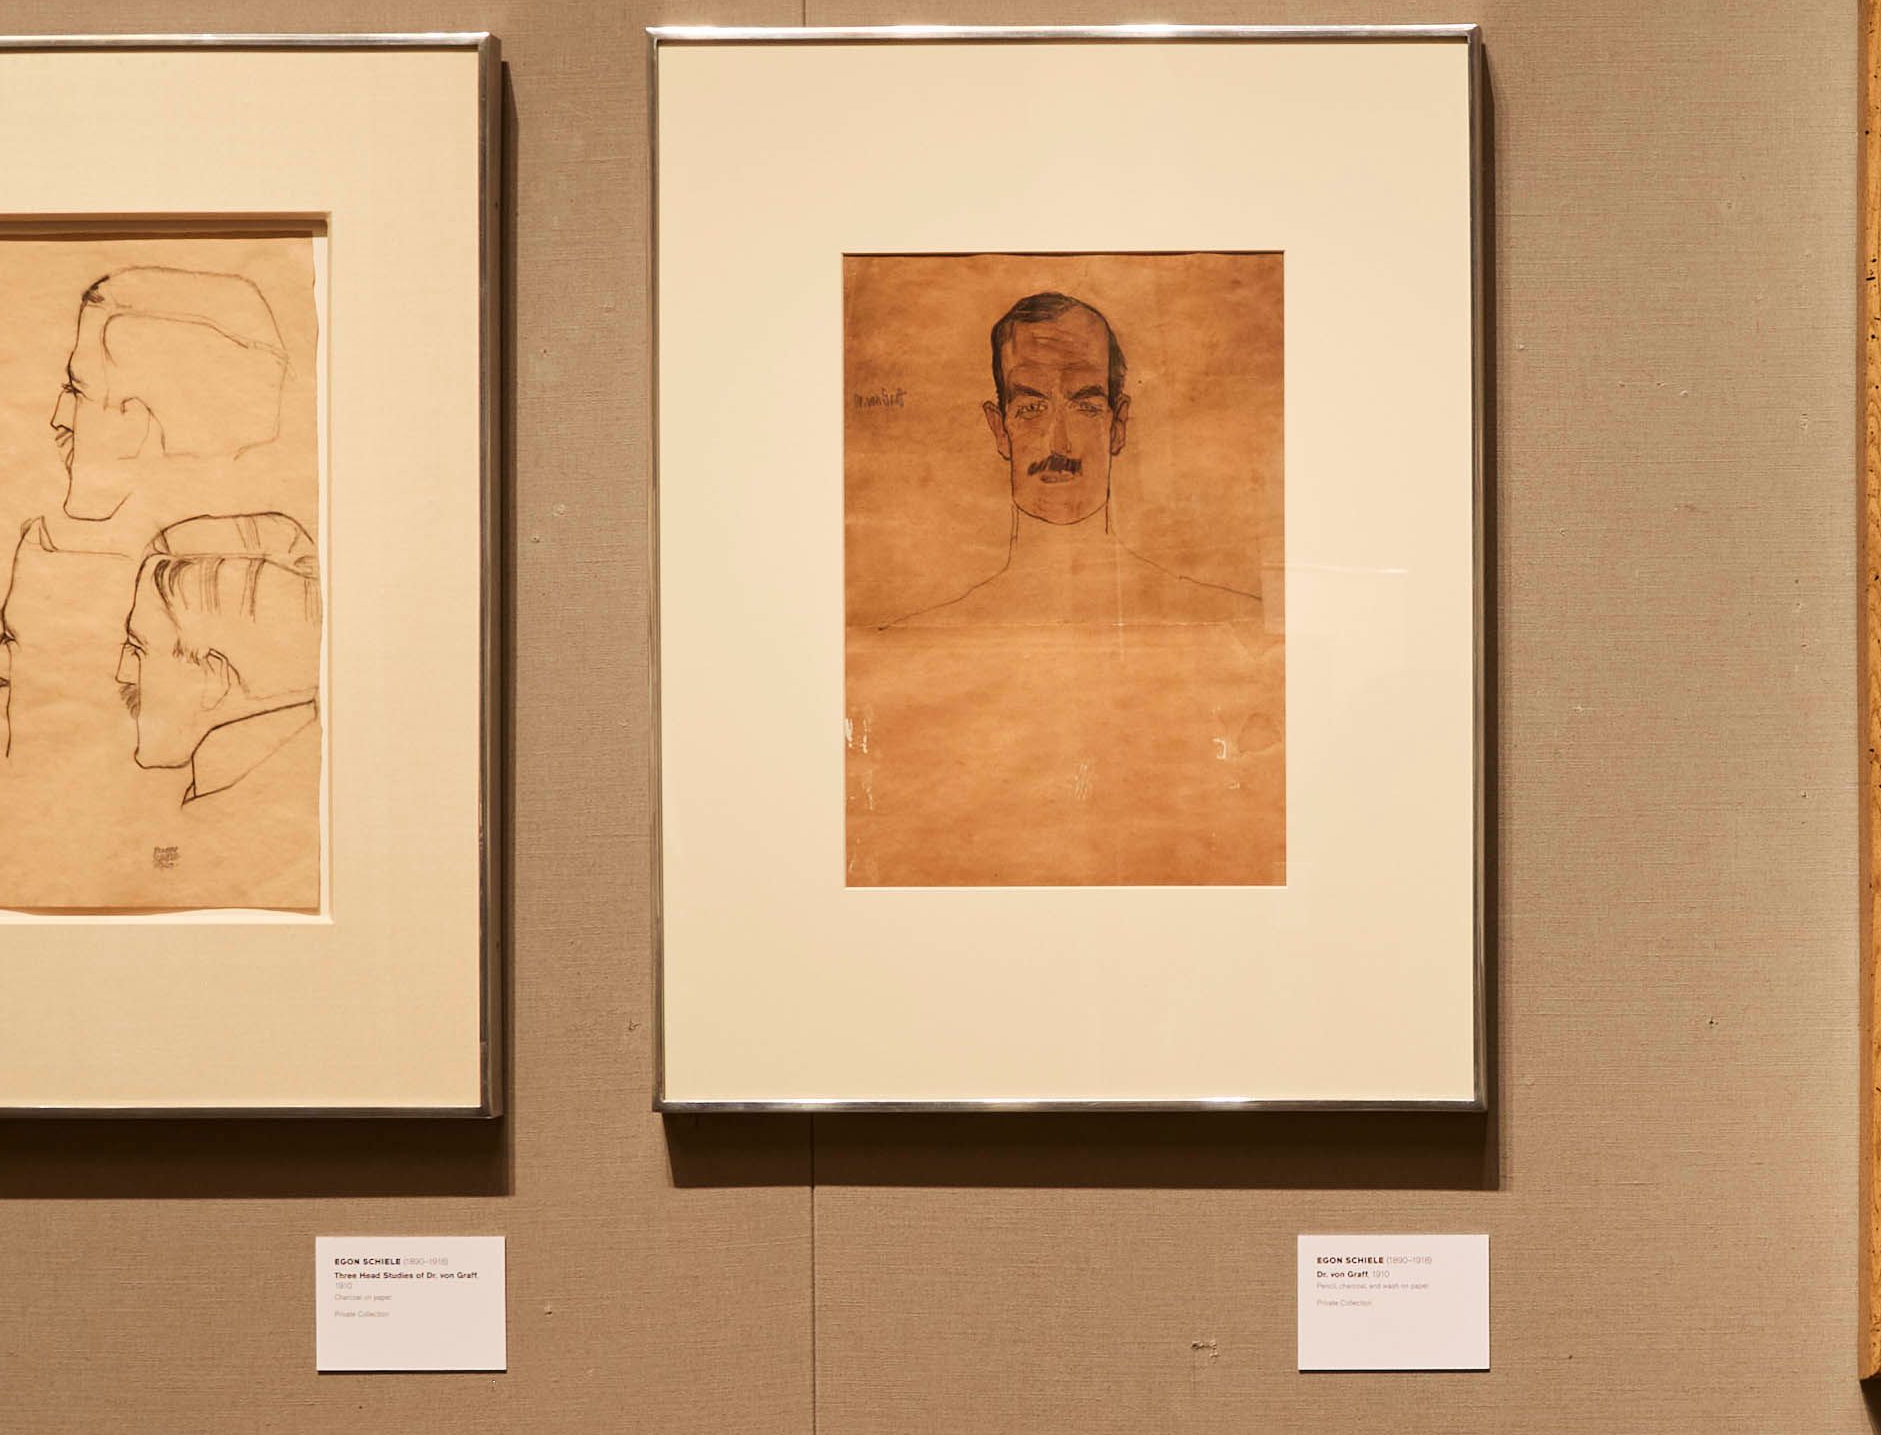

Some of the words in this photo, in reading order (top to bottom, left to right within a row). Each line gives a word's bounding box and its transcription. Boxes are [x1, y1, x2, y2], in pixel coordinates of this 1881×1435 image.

[334, 1258, 361, 1266] EGON
[363, 1258, 401, 1266] SCHIELE
[334, 1272, 357, 1280] Three
[359, 1272, 381, 1280] Head
[383, 1272, 414, 1280] Studies
[416, 1272, 424, 1280] of
[426, 1272, 439, 1280] Dr.
